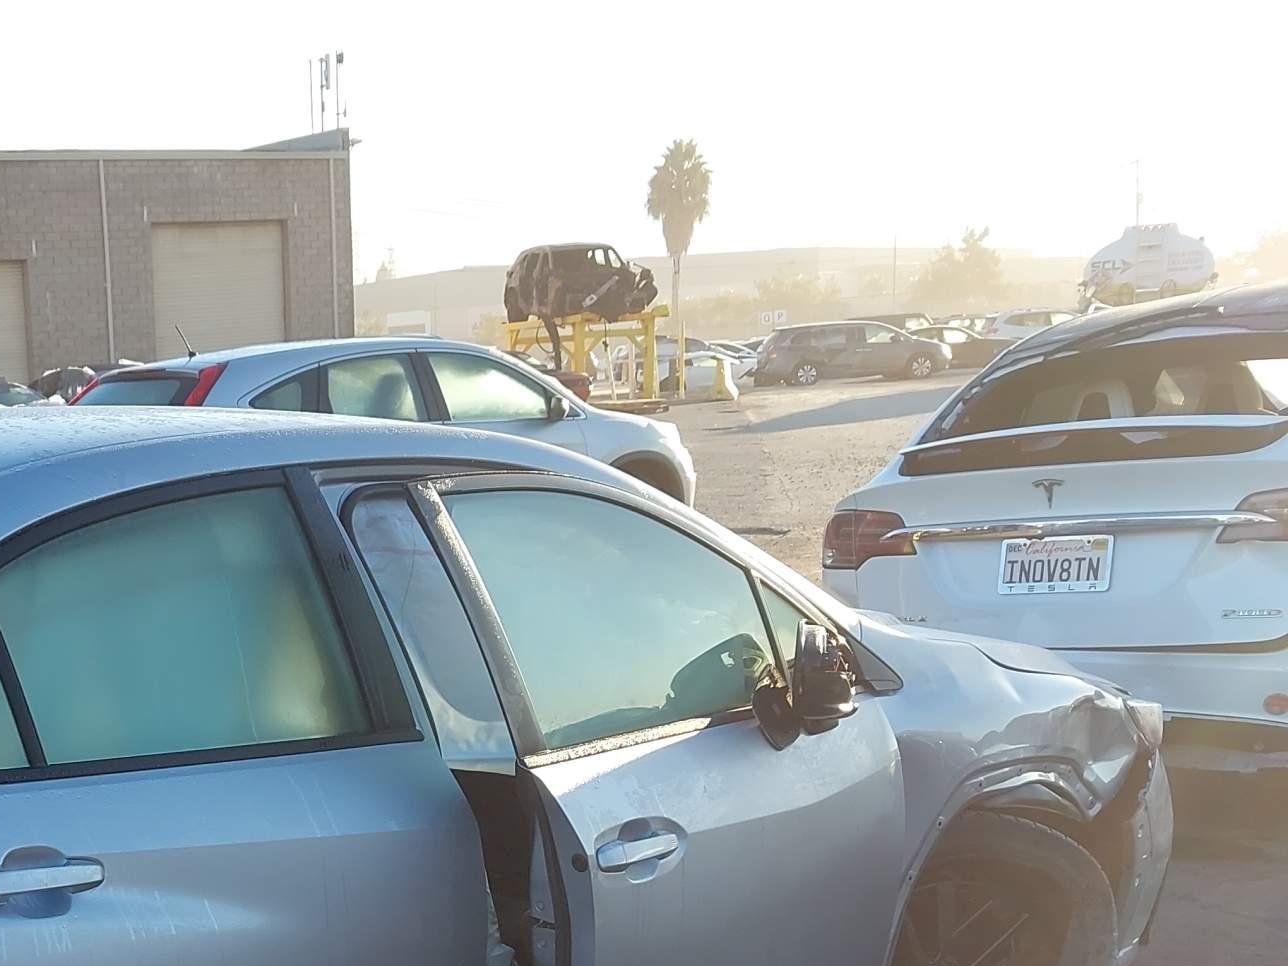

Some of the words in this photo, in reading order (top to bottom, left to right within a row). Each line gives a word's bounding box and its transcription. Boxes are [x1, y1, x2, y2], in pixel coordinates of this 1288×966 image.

[1090, 259, 1121, 273] SCL
[1008, 544, 1022, 553] DEC
[1025, 540, 1085, 558] California
[1005, 556, 1100, 584] INOV8TN
[1007, 583, 1097, 593] TESLA
